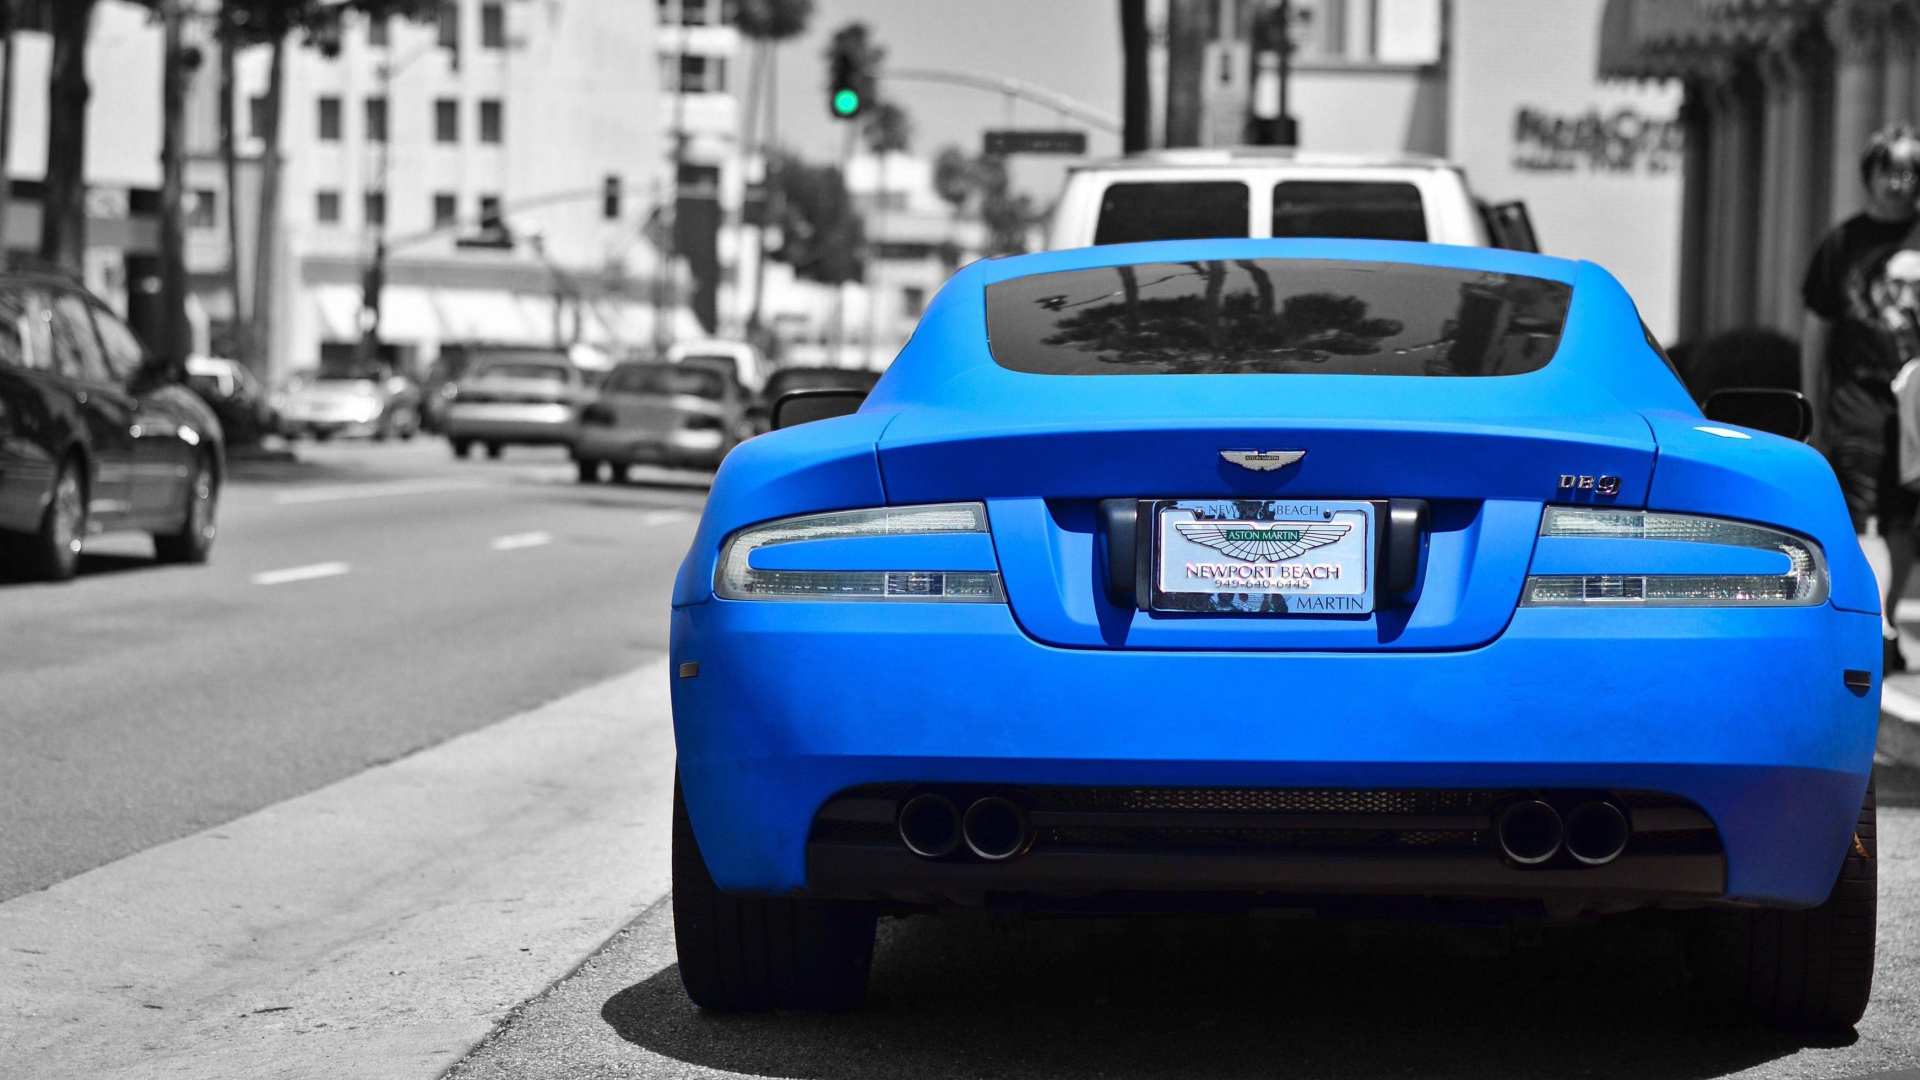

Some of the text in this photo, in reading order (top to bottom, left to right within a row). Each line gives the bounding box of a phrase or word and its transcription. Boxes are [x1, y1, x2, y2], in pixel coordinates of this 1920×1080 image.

[1558, 474, 1622, 495] DB9
[1276, 504, 1319, 516] BEACH
[1228, 531, 1299, 540] ASTON MARTIN
[1185, 564, 1340, 580] NEWPORT BEACH
[1214, 578, 1311, 589] 949-640-6445
[1296, 596, 1364, 610] MARTIN
